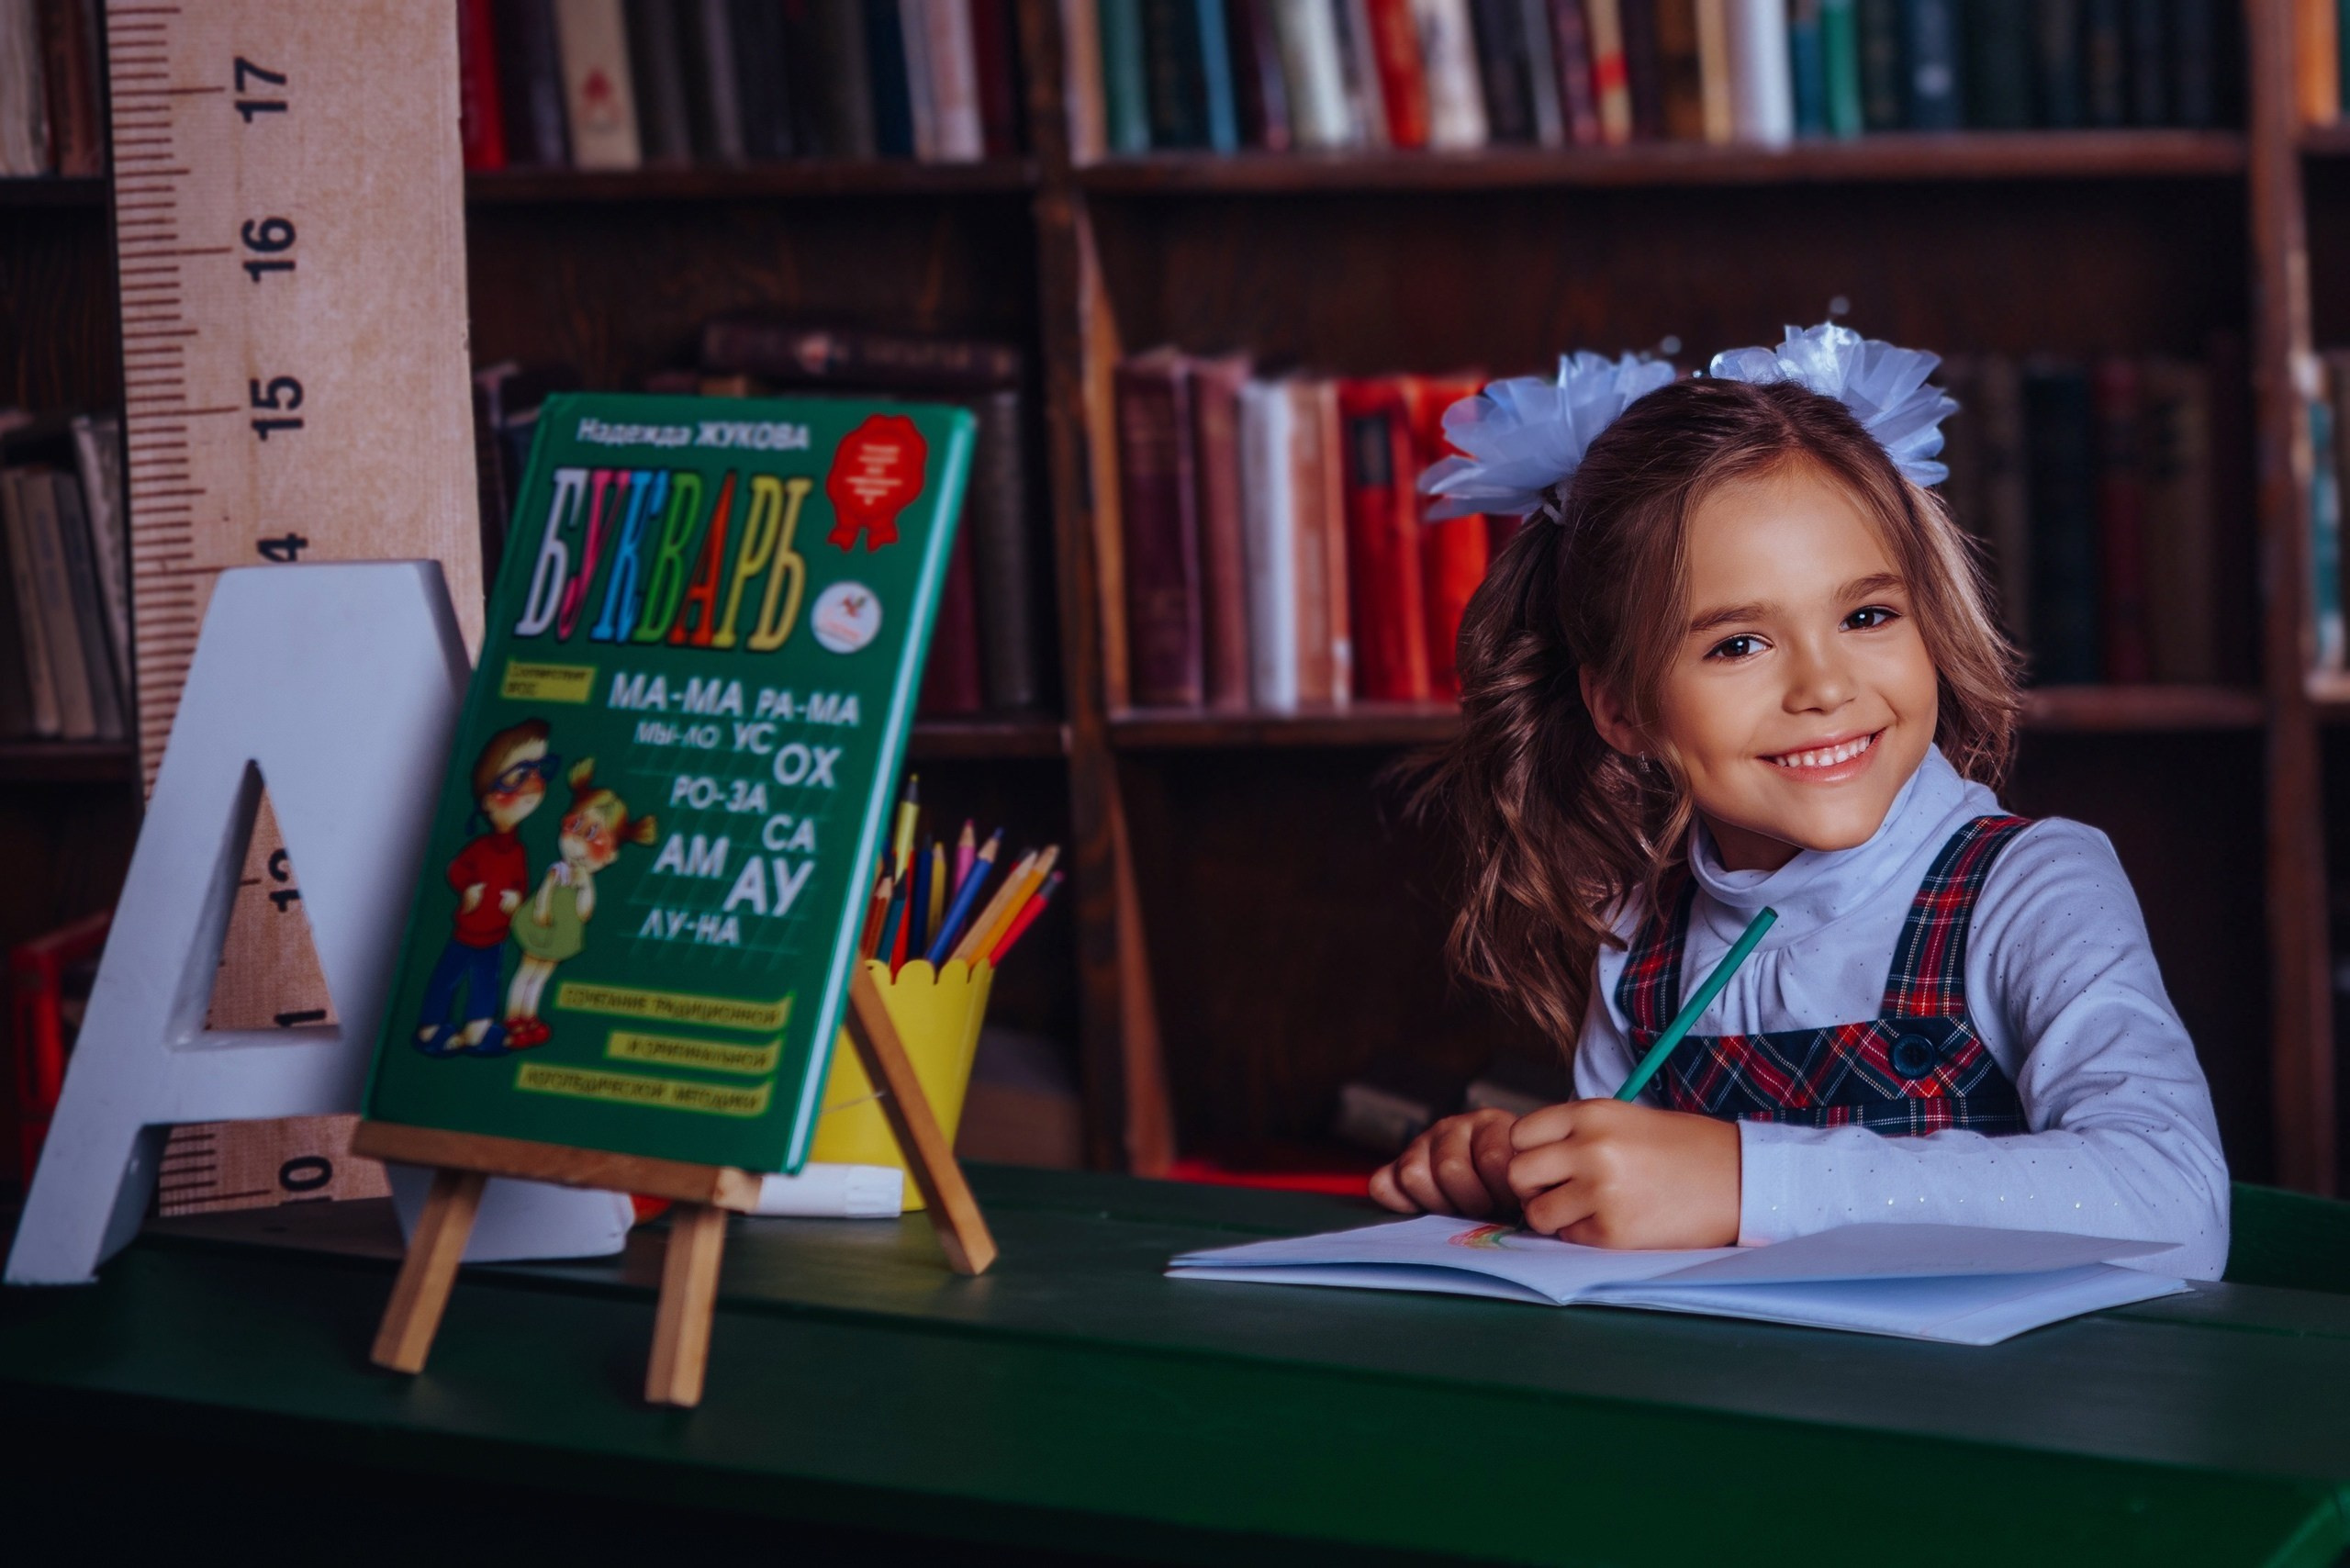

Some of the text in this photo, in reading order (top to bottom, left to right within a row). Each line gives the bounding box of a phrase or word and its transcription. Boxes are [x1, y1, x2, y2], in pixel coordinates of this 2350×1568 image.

[233, 55, 288, 124] 17
[241, 216, 297, 284] 16
[248, 375, 305, 442] 15
[576, 419, 811, 450] Надежда ЖУКОВА
[256, 532, 308, 564] 4
[514, 467, 813, 652] БУКВАРЬ
[608, 671, 861, 726] МА-МА РА-МА
[633, 721, 778, 756] МЫ-ЛО УС
[773, 741, 842, 789] ОХ
[669, 775, 768, 814] РО-ЗА
[762, 812, 816, 854] СА
[652, 833, 816, 918] АМ АУ
[640, 908, 741, 946] ЛУ-НА
